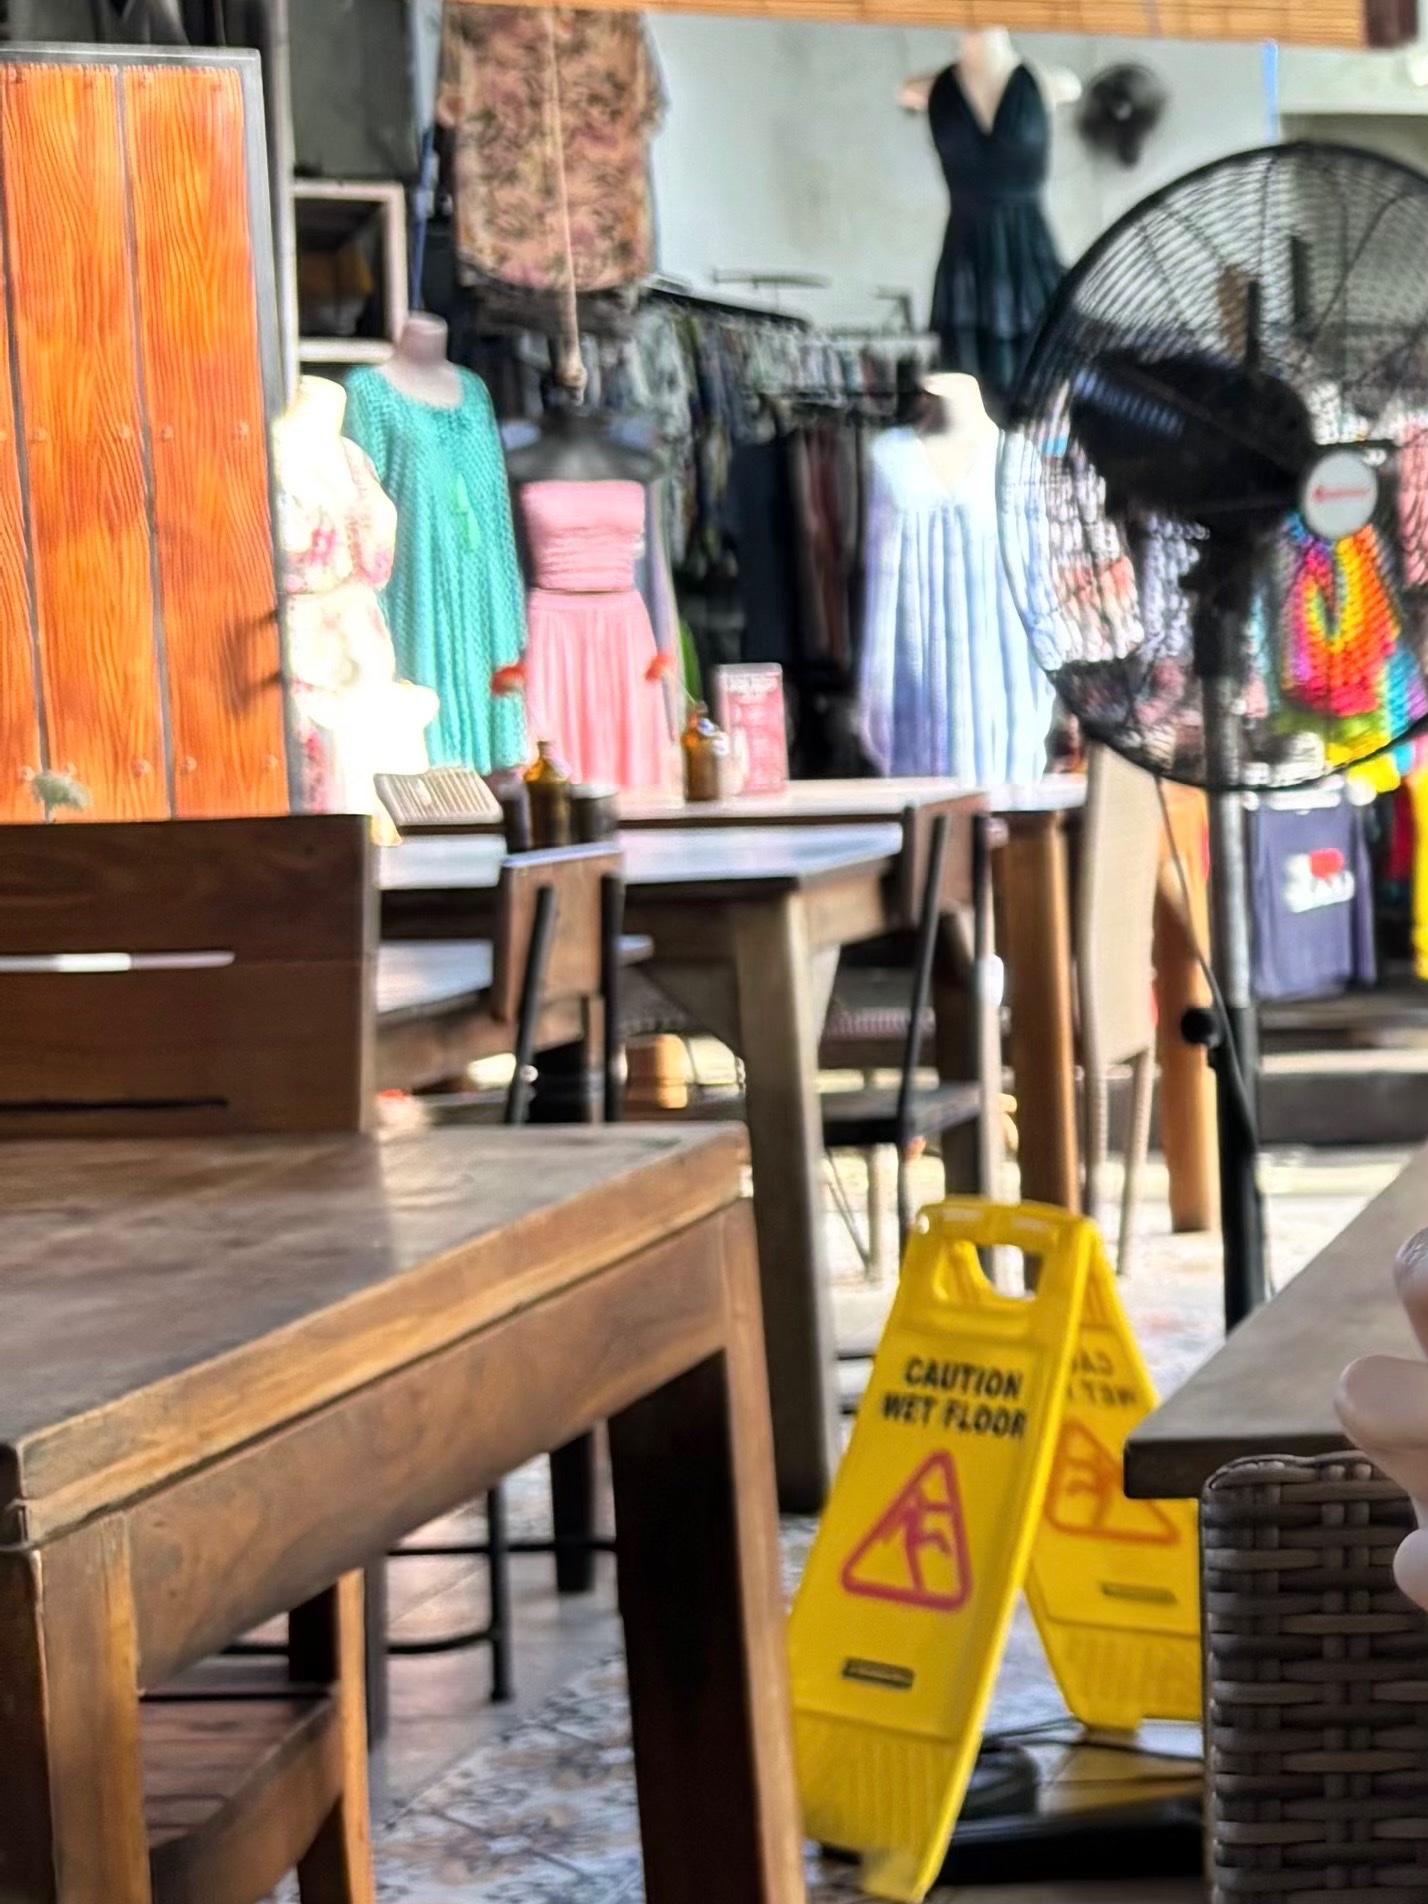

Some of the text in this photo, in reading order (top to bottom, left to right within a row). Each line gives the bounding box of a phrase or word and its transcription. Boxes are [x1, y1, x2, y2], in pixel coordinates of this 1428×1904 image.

[904, 1356, 1023, 1400] CAUTION
[881, 1392, 1028, 1439] WET FLOOR
